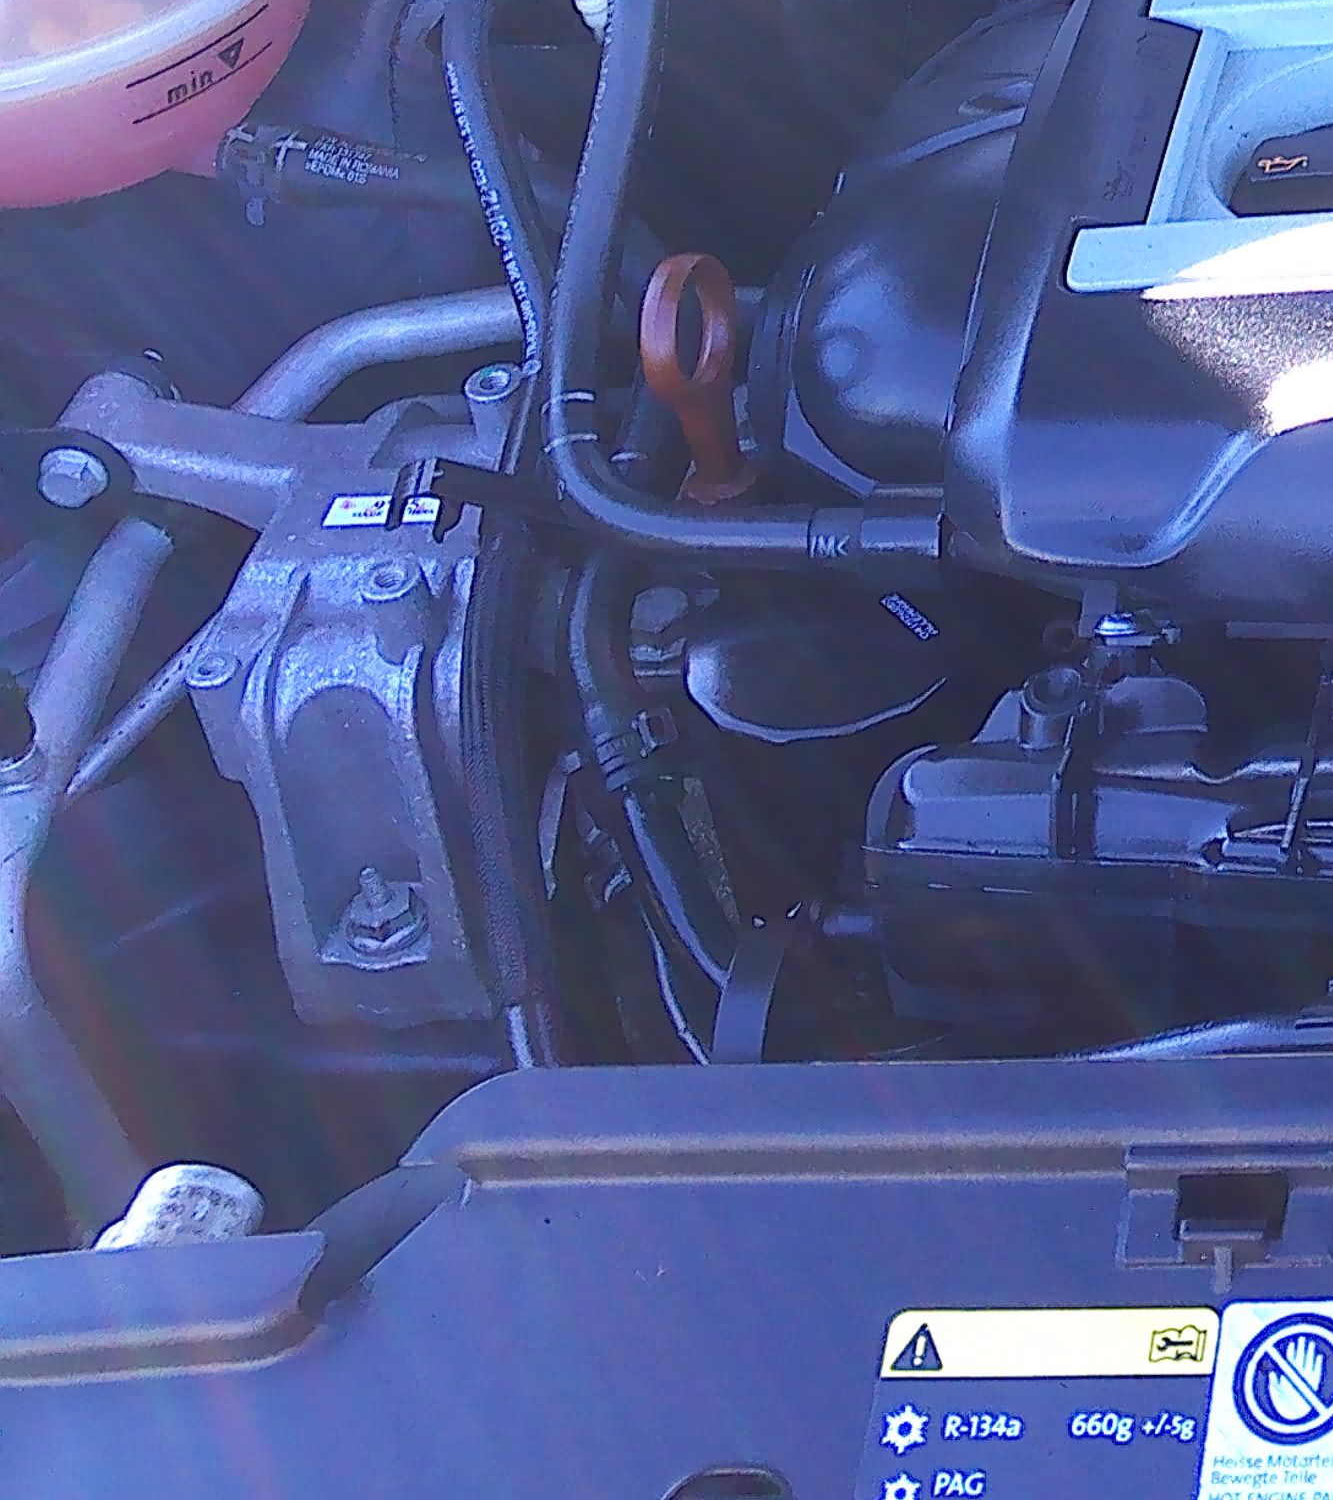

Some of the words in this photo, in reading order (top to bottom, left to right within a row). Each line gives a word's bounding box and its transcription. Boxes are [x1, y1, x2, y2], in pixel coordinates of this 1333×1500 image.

[166, 68, 215, 105] min
[943, 1413, 1022, 1440] R-134a
[1071, 1413, 1136, 1443] 660g
[1213, 1454, 1264, 1469] Heisse
[932, 1471, 985, 1496] PAG
[1210, 1470, 1278, 1489] Bewegte
[1283, 1470, 1317, 1485] Teile
